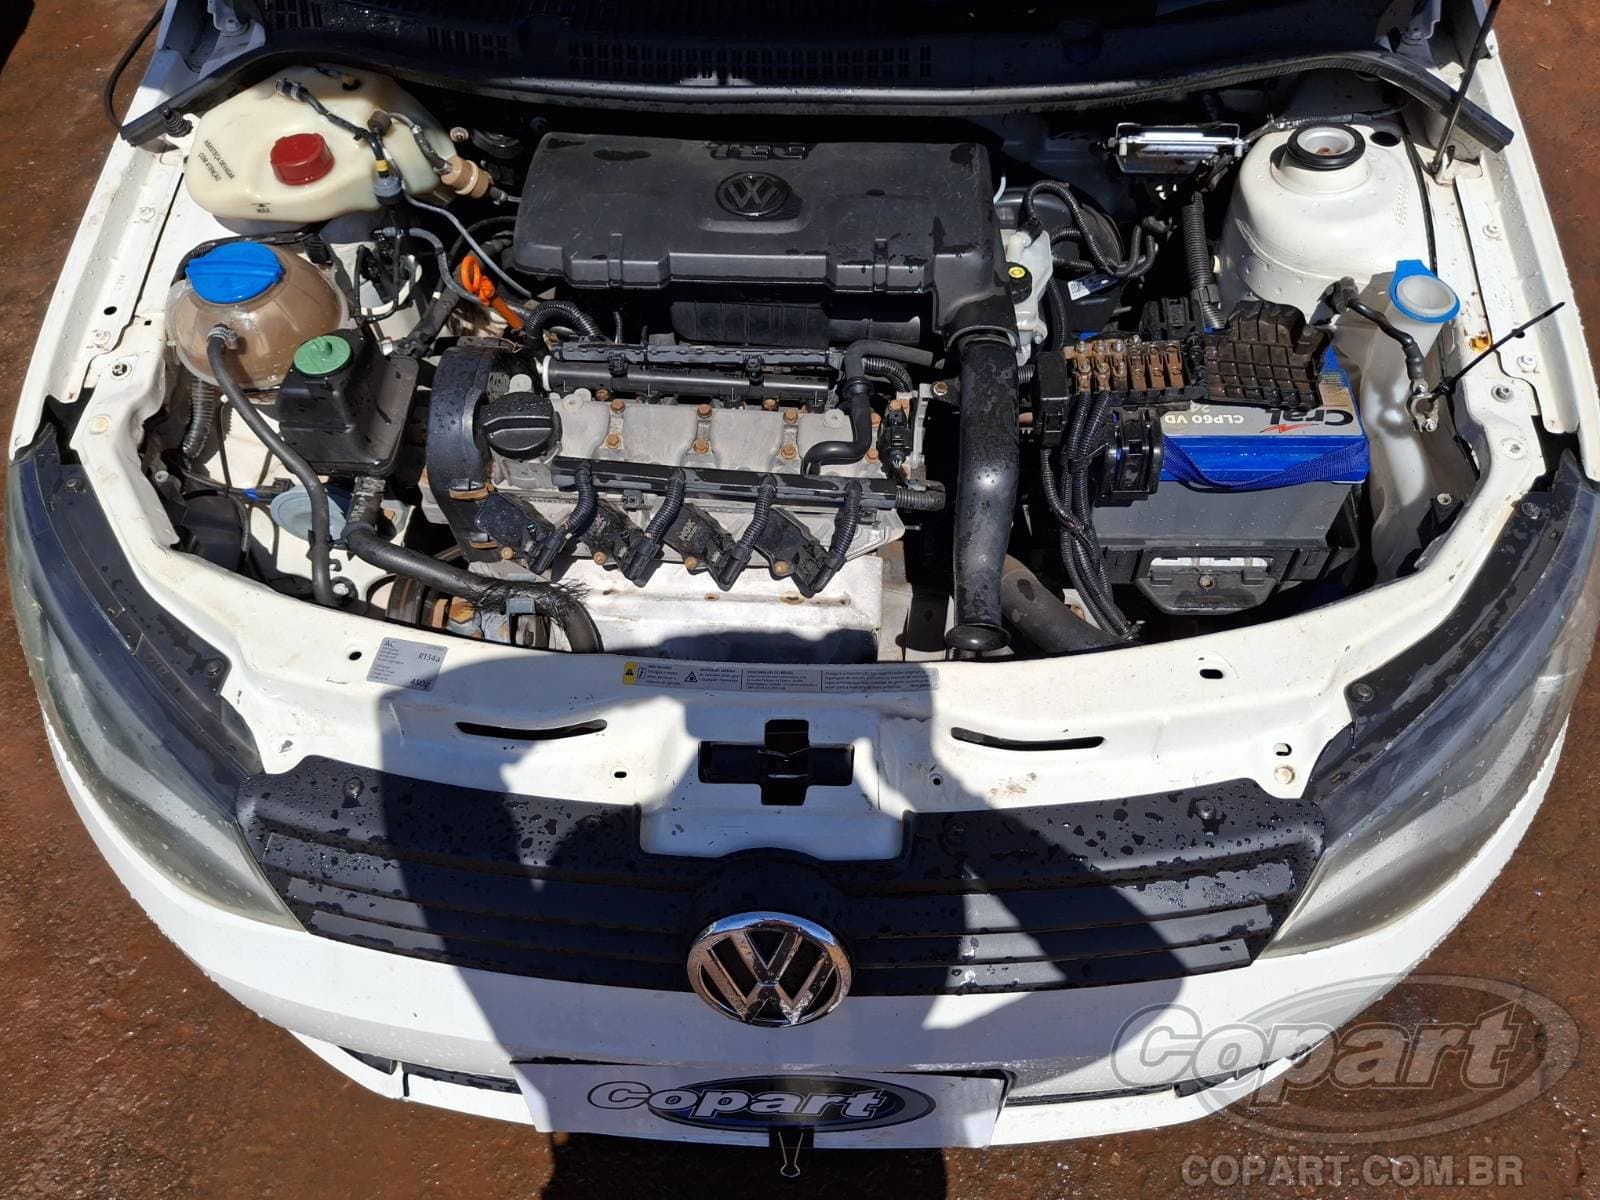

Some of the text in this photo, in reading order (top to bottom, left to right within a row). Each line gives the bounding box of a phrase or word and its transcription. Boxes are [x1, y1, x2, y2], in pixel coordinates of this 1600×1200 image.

[1164, 414, 1244, 424] CLP60 VD
[384, 640, 397, 648] AC
[418, 652, 441, 663] R134a
[692, 920, 844, 1026] VW
[588, 1081, 886, 1118] Copart
